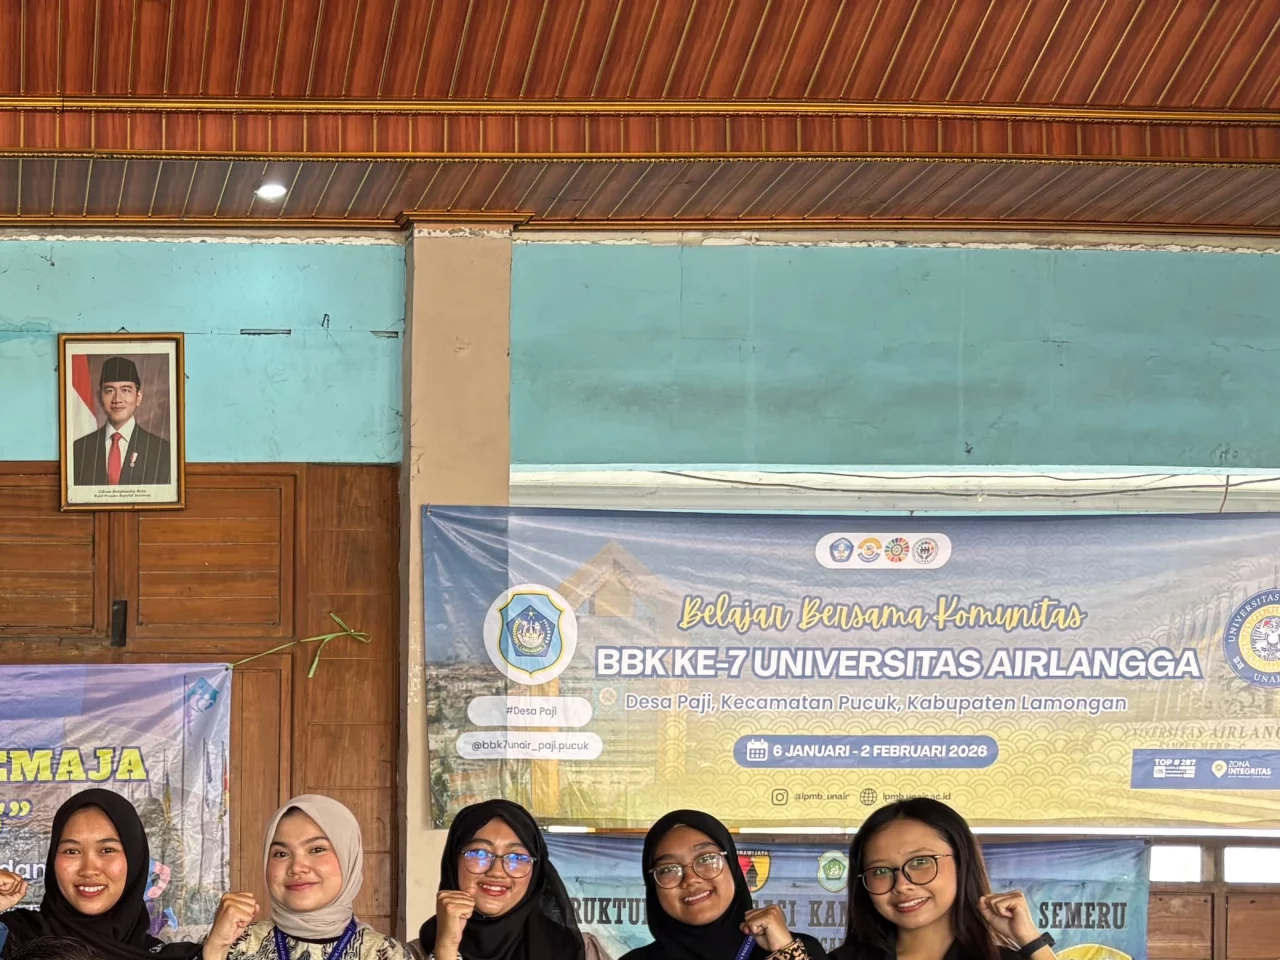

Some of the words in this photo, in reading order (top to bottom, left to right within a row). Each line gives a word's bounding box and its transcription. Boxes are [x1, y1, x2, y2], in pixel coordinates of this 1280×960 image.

[679, 594, 790, 633] Belajar
[798, 595, 929, 631] Bersama
[934, 595, 1087, 633] Komunitas
[1228, 593, 1280, 643] UNIVERSITAS
[596, 648, 667, 676] BBK
[674, 648, 748, 677] KE-7
[753, 649, 984, 678] UNIVERSITAS
[986, 649, 1201, 678] AIRLANGGA
[1254, 673, 1280, 683] UNAI
[505, 706, 537, 716] #Desa
[539, 706, 557, 719] Paji
[626, 694, 672, 710] Desa
[677, 694, 716, 714] Paji,
[721, 694, 834, 711] Kecamatan
[838, 694, 902, 714] Pucuk,
[907, 695, 1017, 715] Kabupaten
[1021, 696, 1127, 715] Lamongan
[472, 740, 589, 753] @bbk7unair_paji.pucuk
[773, 745, 782, 757] 6
[785, 745, 850, 758] JANUARI
[861, 745, 870, 758] 2
[873, 745, 947, 758] FEBRUARI
[949, 745, 988, 758] 2026
[1228, 767, 1272, 775] INTEGRITAS
[0, 859, 46, 880] dan
[569, 897, 648, 925] RUKTU
[1038, 901, 1128, 930] SEMERU
